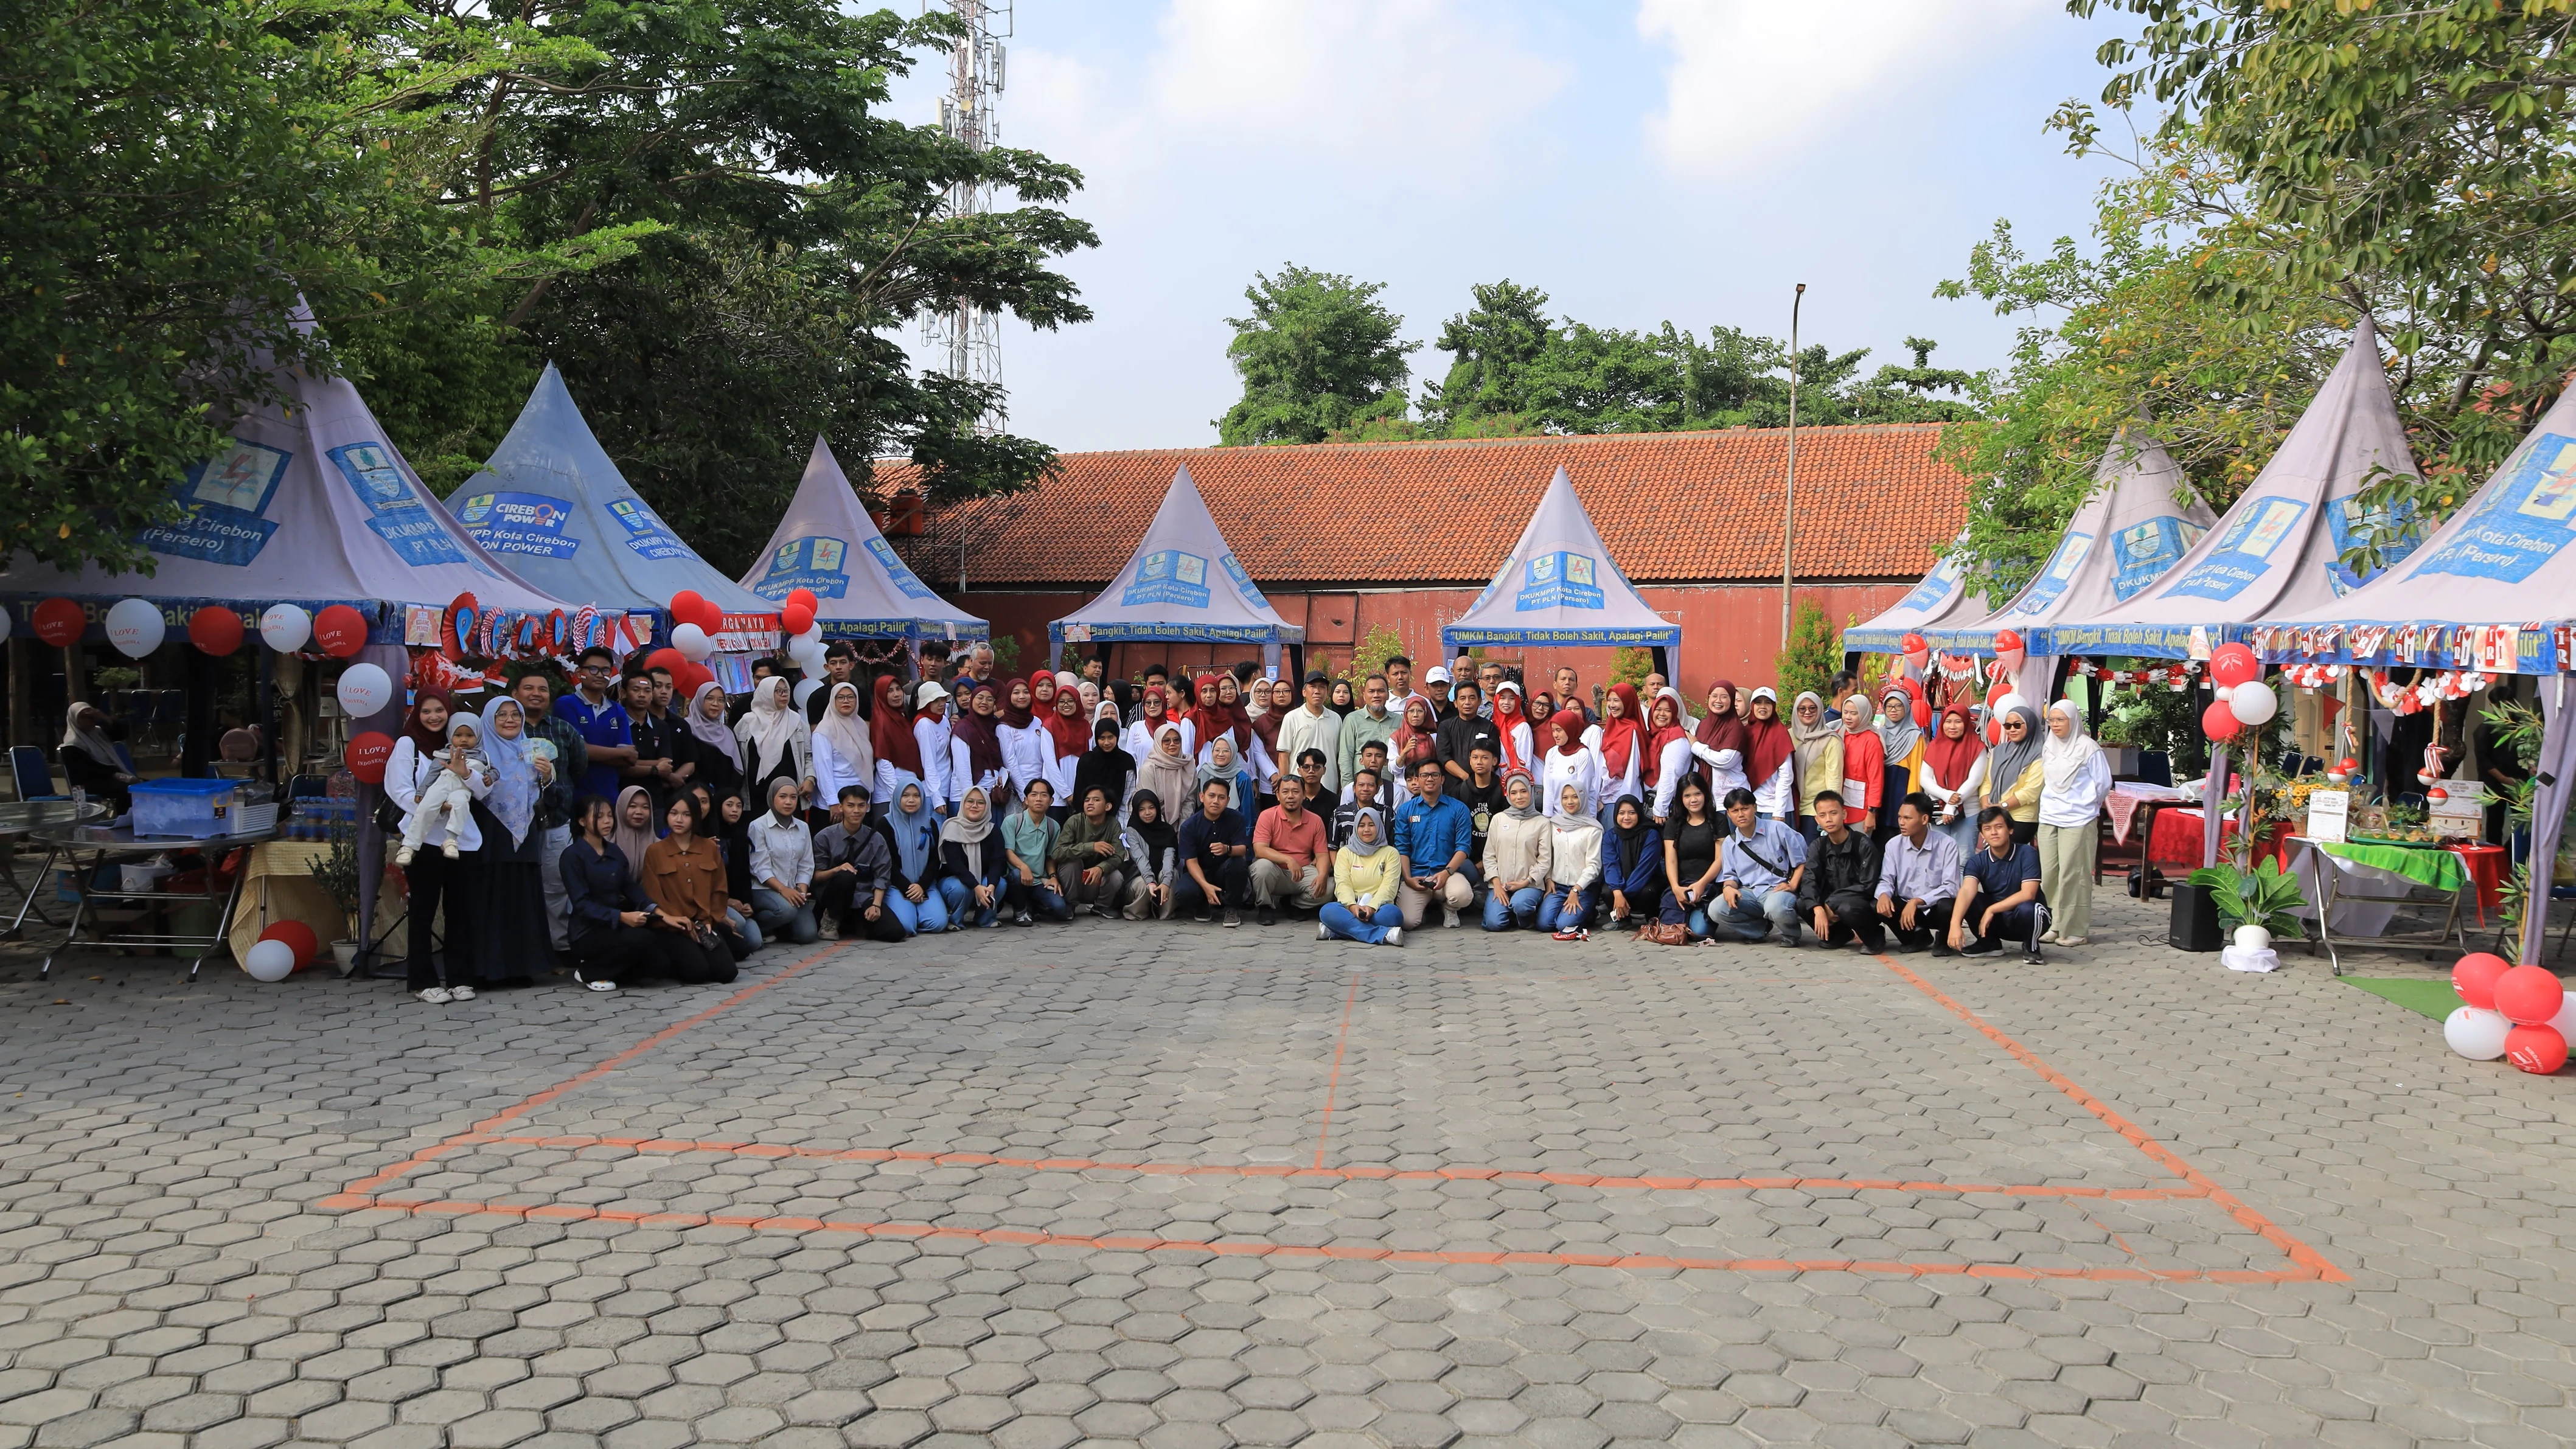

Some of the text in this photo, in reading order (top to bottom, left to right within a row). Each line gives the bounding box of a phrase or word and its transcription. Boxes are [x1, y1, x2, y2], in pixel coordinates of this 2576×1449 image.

[495, 503, 566, 521] CIREBON
[197, 518, 262, 541] Cirebon
[143, 527, 225, 552] (Persero)
[493, 530, 523, 540] Kota
[526, 533, 576, 548] Cirebon
[2474, 524, 2557, 554] Kota Cirebon
[411, 541, 428, 553] PT
[502, 542, 552, 555] POWER
[756, 579, 795, 592] DKUKMPP
[816, 576, 844, 585] Cirebon
[1163, 591, 1194, 602] (Persero)
[1180, 587, 1207, 597] Cirebon
[1520, 587, 1555, 600] DKUKMPP
[1574, 589, 1601, 598] Cirebon
[1558, 593, 1589, 604] (Persero)
[43, 621, 63, 630] LOVE
[722, 617, 765, 630] RGAHAYU
[839, 622, 877, 634] Apalagi
[114, 628, 139, 636] LOVE
[322, 630, 342, 640] LOVE
[1091, 625, 1127, 638] Bangkit,
[1129, 625, 1153, 634] Tidak
[1156, 625, 1180, 636] Boleh
[1183, 627, 1207, 638] Sakit,
[1209, 628, 1242, 639] Apalagi
[1486, 631, 1523, 642] Bangkit,
[1526, 631, 1550, 641] Tidak
[1553, 631, 1579, 641] Boleh
[1582, 631, 1606, 642] Sakit,
[1609, 631, 1643, 642] Apalagi
[2104, 628, 2123, 644] Tidak
[2123, 628, 2143, 644] Boleh
[2163, 630, 2190, 652] Apalag
[349, 687, 372, 697] LOVE
[343, 697, 367, 706] INDONESIA
[364, 746, 387, 755] LOVE
[358, 758, 386, 766] INDONESIA
